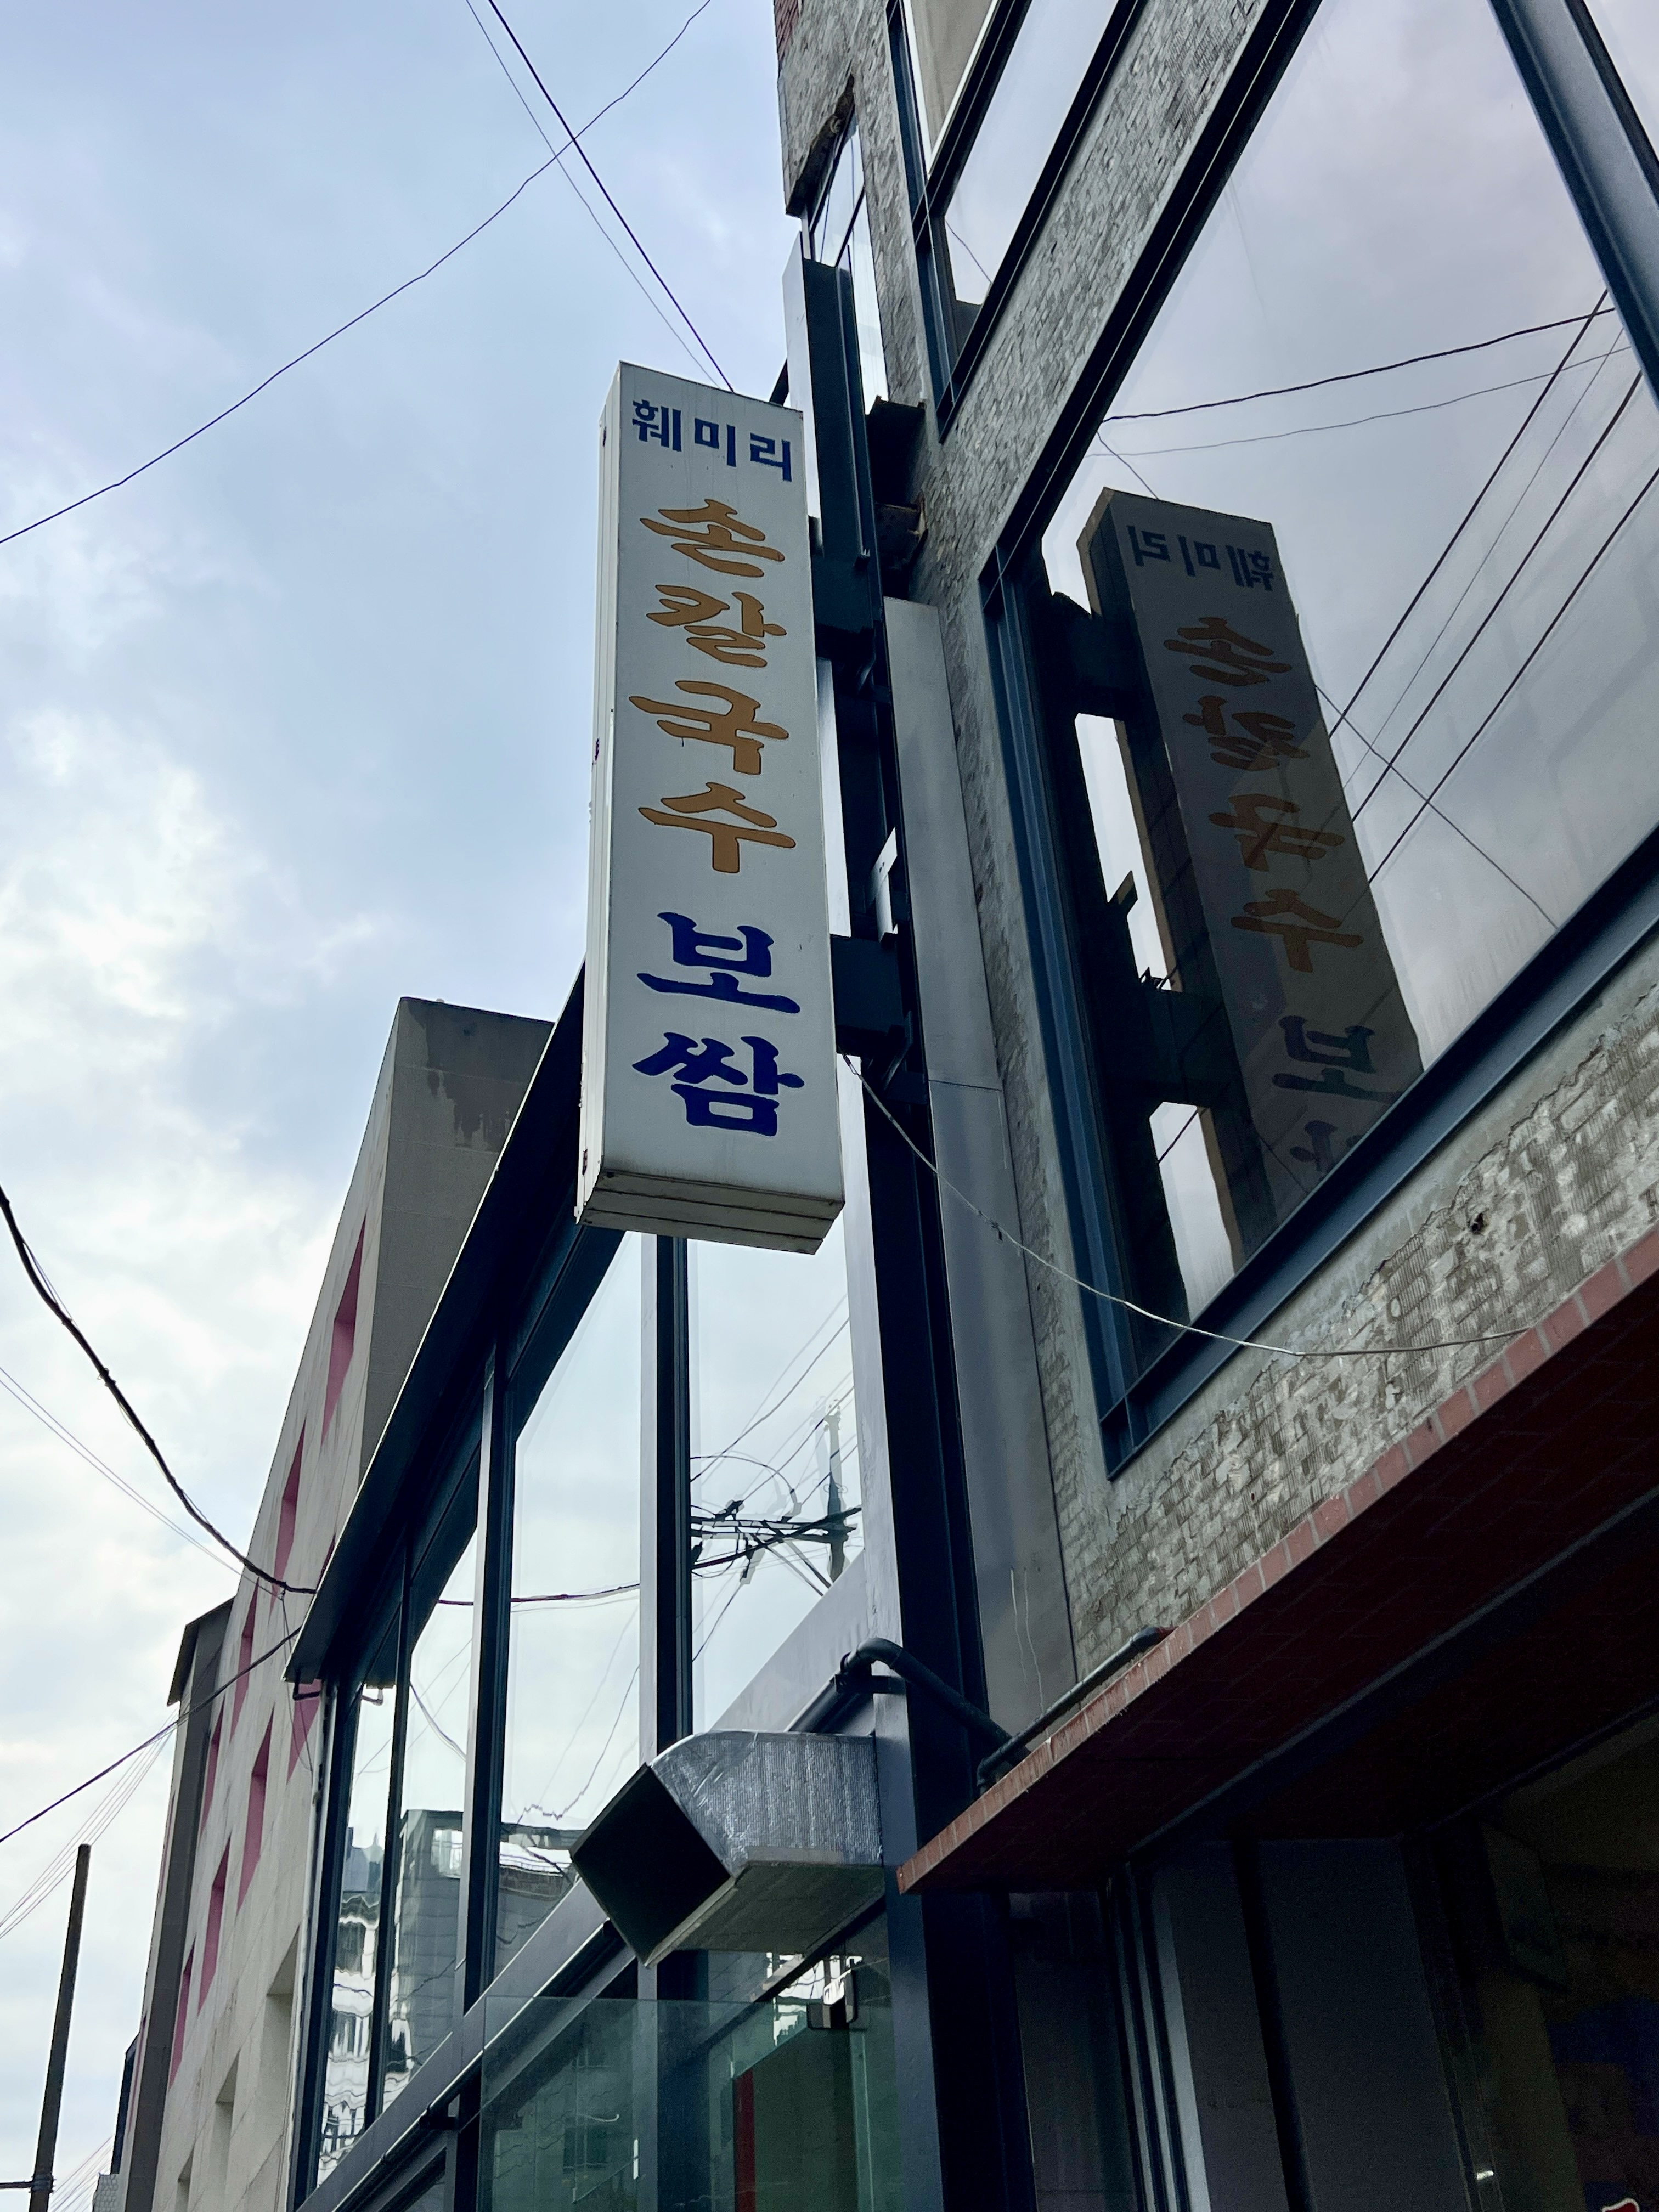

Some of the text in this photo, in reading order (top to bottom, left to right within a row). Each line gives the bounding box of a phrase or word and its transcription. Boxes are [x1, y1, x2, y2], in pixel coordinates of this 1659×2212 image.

[632, 399, 792, 482] 훼미리
[629, 498, 796, 873] 손칼국수
[632, 912, 805, 1136] 보쌈
